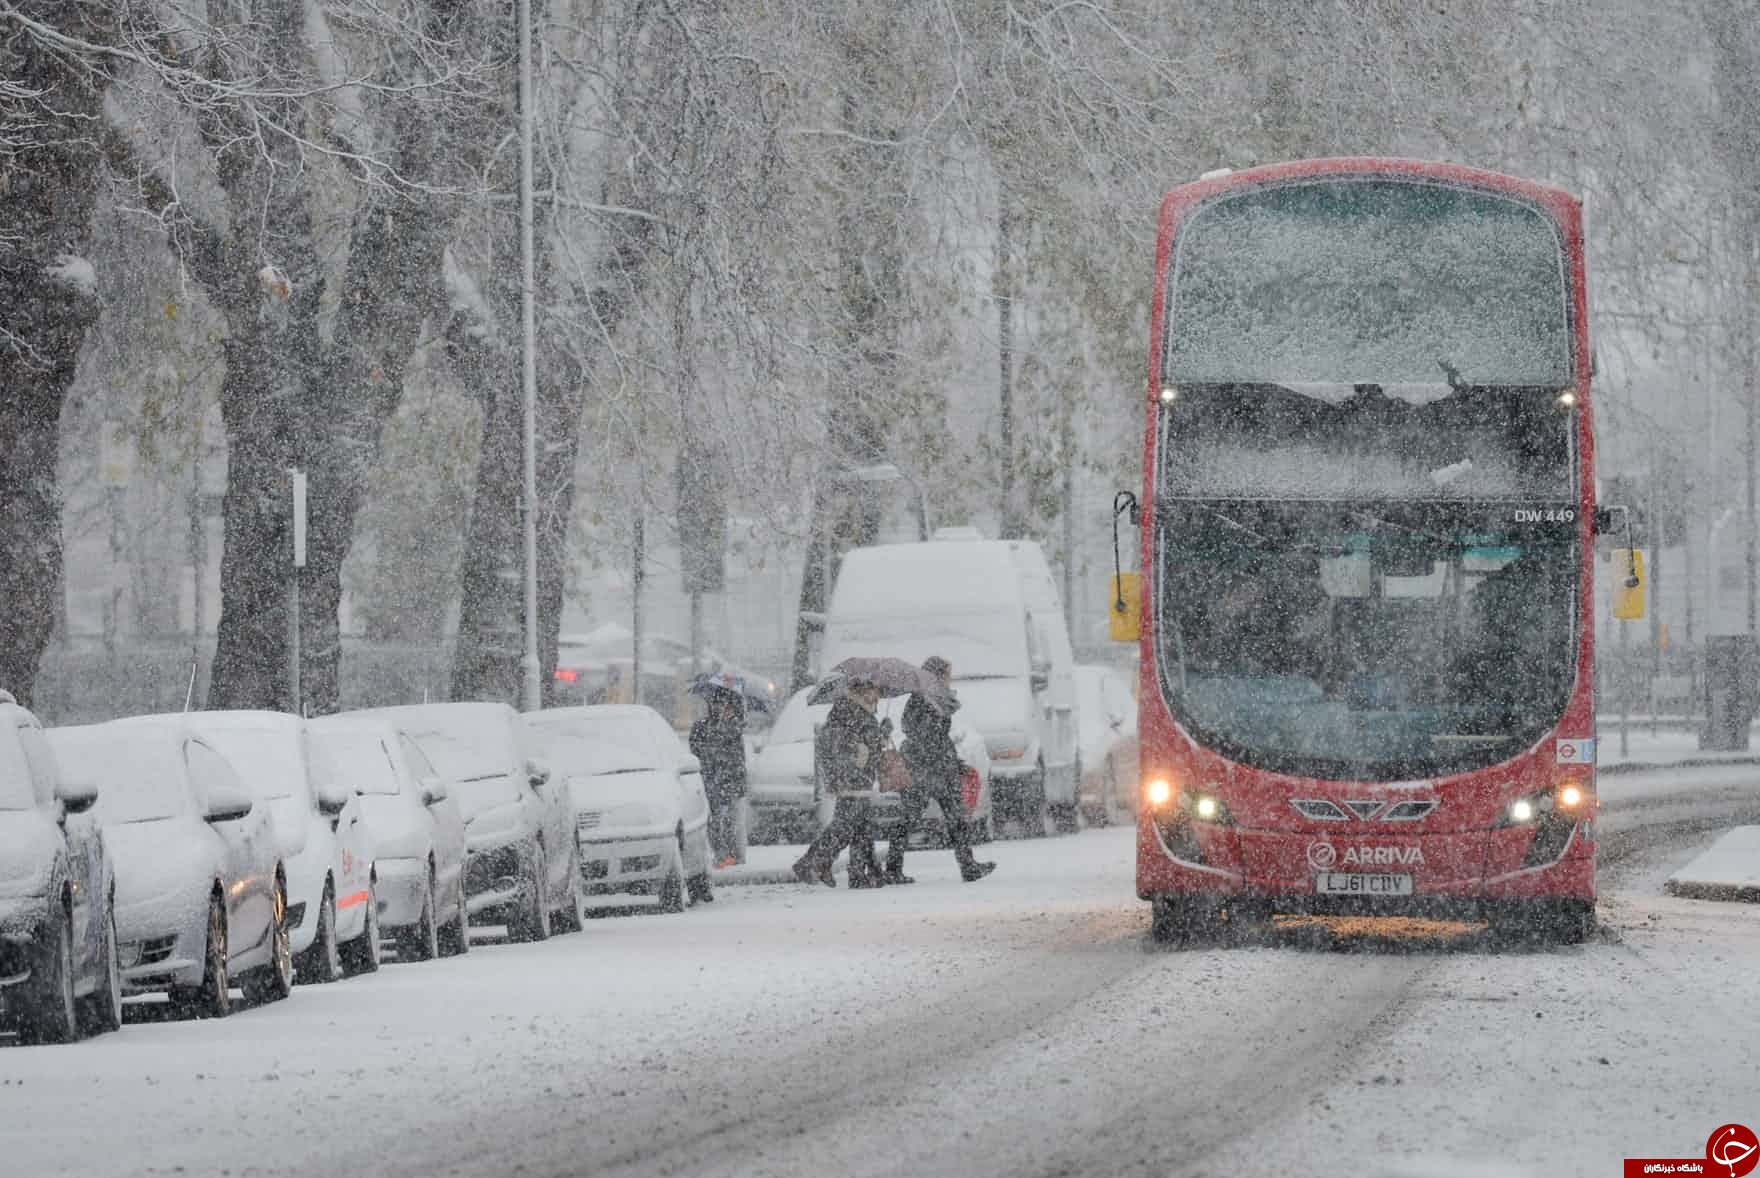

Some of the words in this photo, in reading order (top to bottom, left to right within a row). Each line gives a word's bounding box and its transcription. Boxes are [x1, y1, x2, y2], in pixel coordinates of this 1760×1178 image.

[1515, 510, 1542, 521] DW
[1547, 509, 1574, 521] 449
[1344, 847, 1425, 864] ARRIVA
